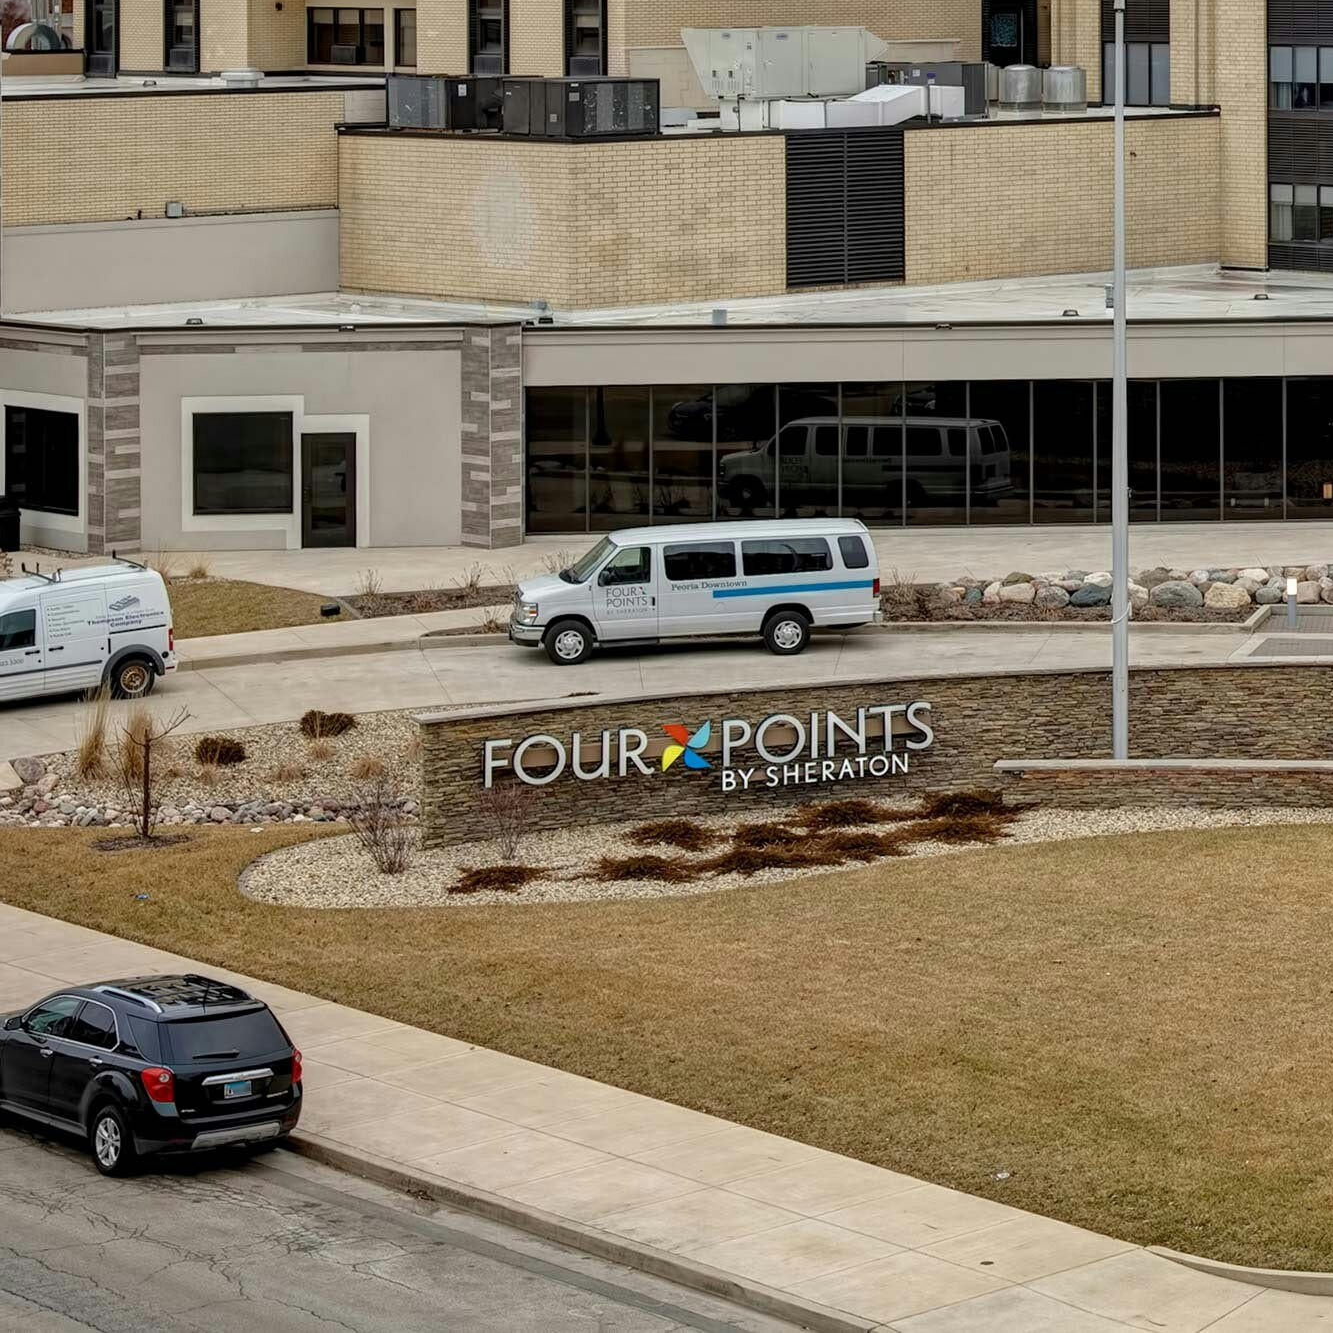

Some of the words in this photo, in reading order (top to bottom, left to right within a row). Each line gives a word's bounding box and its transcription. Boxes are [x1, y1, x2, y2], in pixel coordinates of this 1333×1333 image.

[672, 583, 699, 591] Peoria
[702, 580, 747, 589] Downtown
[606, 586, 638, 597] FOUR
[606, 596, 648, 607] POINTS
[484, 727, 655, 788] FOUR
[722, 701, 934, 767] POINTS
[721, 767, 754, 791] BY
[766, 752, 909, 787] SHERATON
